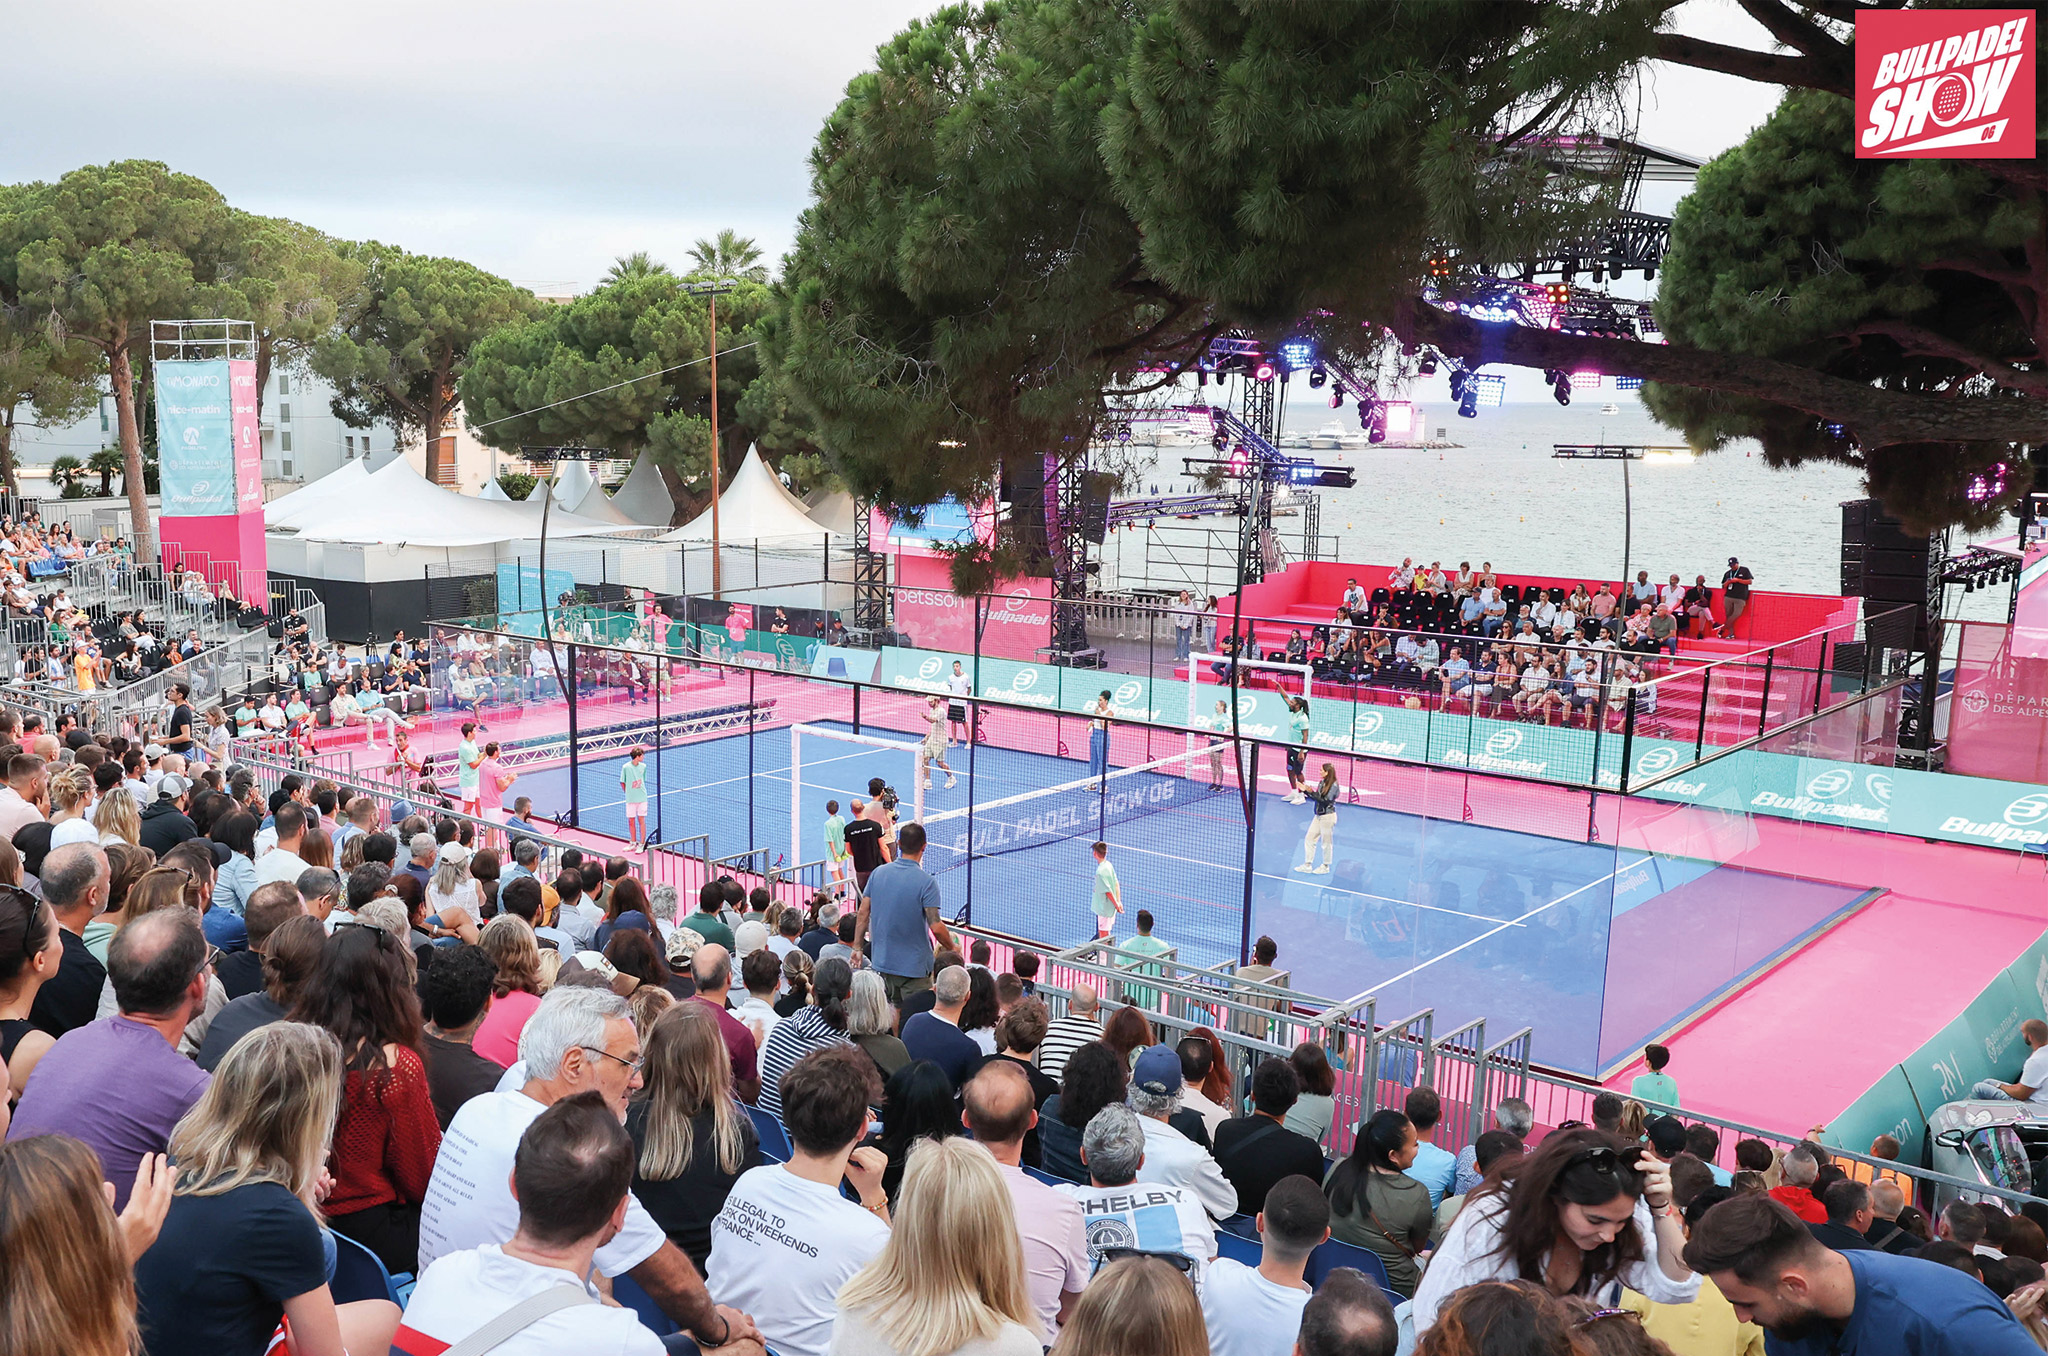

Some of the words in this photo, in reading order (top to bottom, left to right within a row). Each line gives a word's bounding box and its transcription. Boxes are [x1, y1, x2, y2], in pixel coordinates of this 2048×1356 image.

[171, 494, 225, 504] Bullpadel
[897, 588, 965, 609] betsson
[979, 607, 1050, 626] Bullpadel
[894, 675, 951, 692] Bullpade
[984, 686, 1056, 706] Bullpadel
[1083, 700, 1161, 720] Bllpadel
[1993, 704, 2014, 715] DES
[1311, 732, 1407, 755] Bullpadel
[1443, 749, 1548, 774] Bullpadel
[1589, 768, 1707, 796] Bulladel
[732, 1198, 767, 1222] ILLEGAL
[771, 1214, 786, 1229] TO
[721, 1217, 754, 1242] FRANCE
[722, 1206, 738, 1220] ORK
[738, 1213, 755, 1229] ON
[756, 1221, 819, 1258] WEEKENDS
